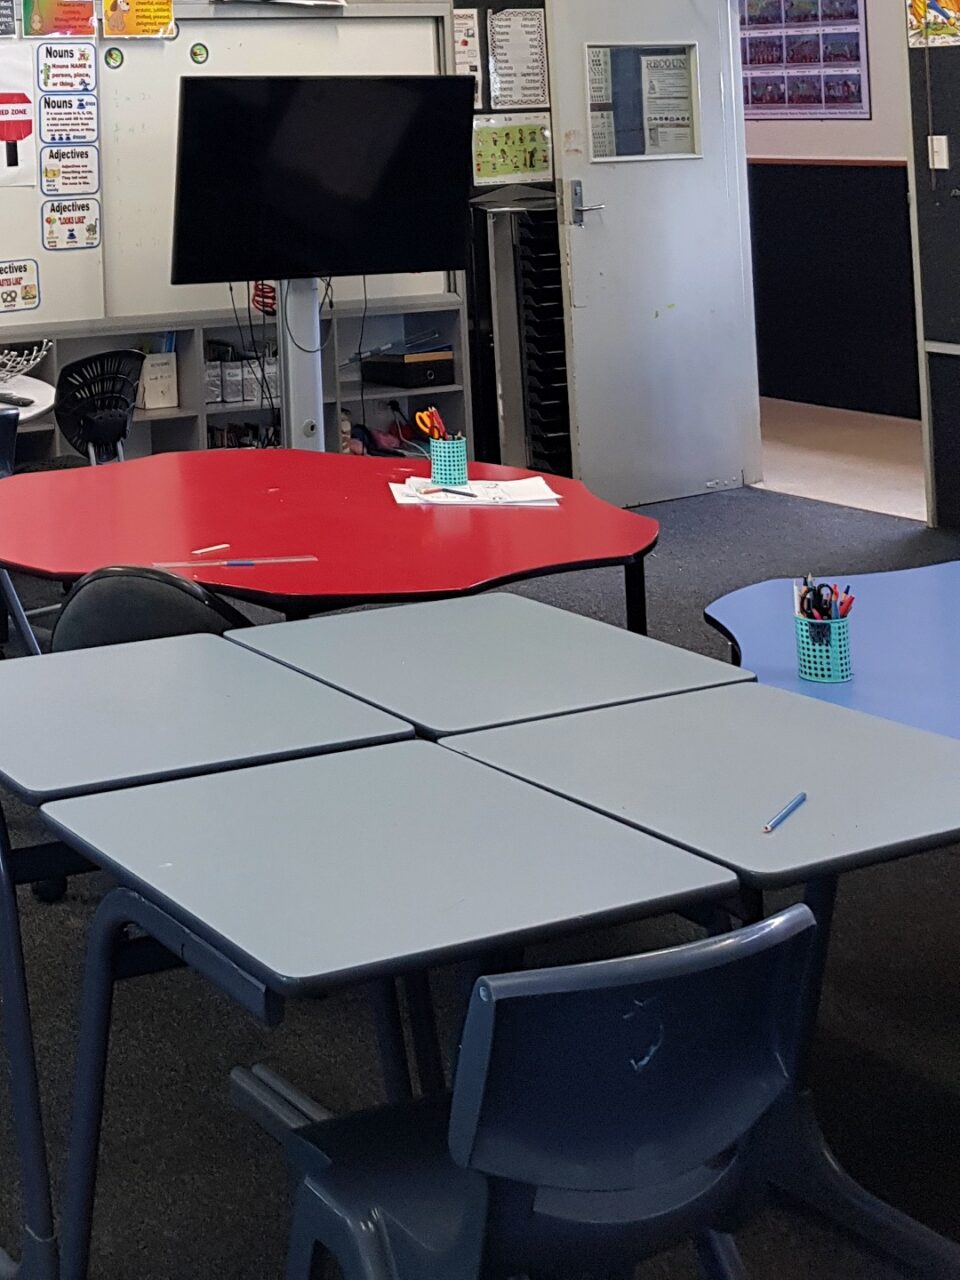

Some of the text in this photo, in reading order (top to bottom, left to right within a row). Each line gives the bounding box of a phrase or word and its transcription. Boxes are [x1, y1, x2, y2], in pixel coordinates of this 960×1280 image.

[46, 47, 74, 58] Nouns
[44, 97, 73, 109] Nouns
[49, 149, 88, 161] Adjectives
[50, 202, 90, 215] Adjectives
